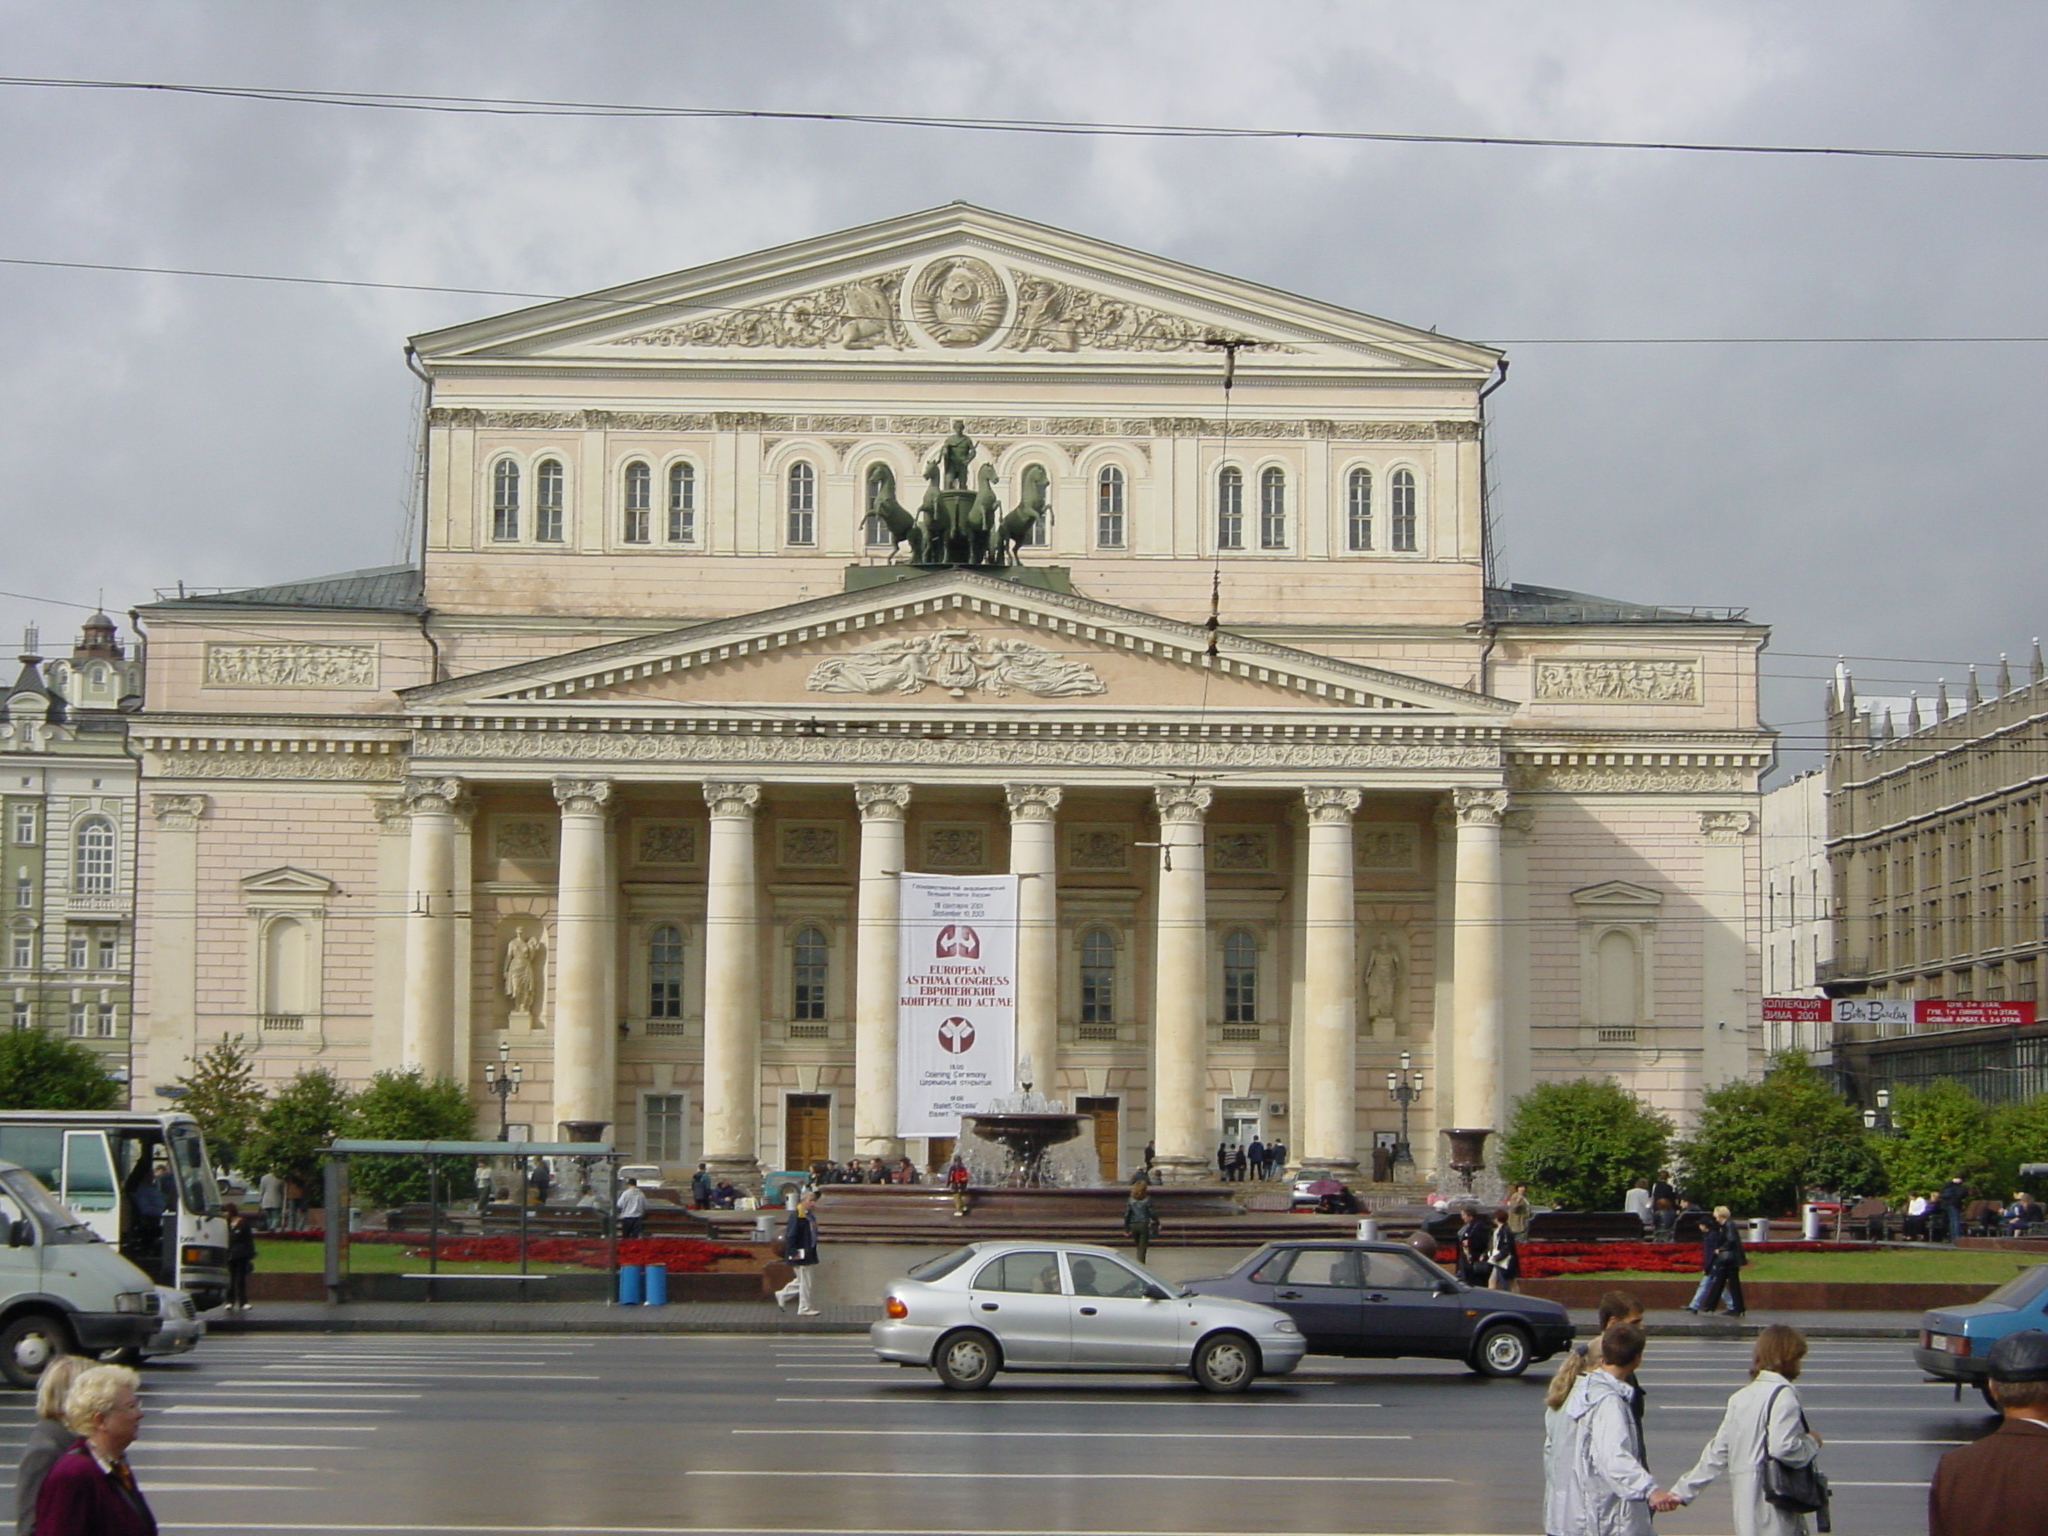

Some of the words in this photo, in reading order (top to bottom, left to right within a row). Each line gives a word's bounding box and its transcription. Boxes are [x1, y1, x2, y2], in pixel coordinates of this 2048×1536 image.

[929, 965, 986, 975] EUROPEAN
[905, 975, 951, 985] ASTHMA
[954, 976, 1010, 986] CONGRESS
[919, 985, 996, 996] ЕВРОПЕЙСКИЙ
[900, 996, 953, 1007] КОНГРЕСС
[956, 997, 972, 1007] ПО
[977, 997, 1014, 1007] АСТМЕ
[1764, 1011, 1793, 1020] ЗИМА
[1797, 1011, 1819, 1020] 2001
[1866, 1000, 1908, 1021] Barclay
[925, 1070, 951, 1079] Opening
[953, 1071, 987, 1079] Ceremony
